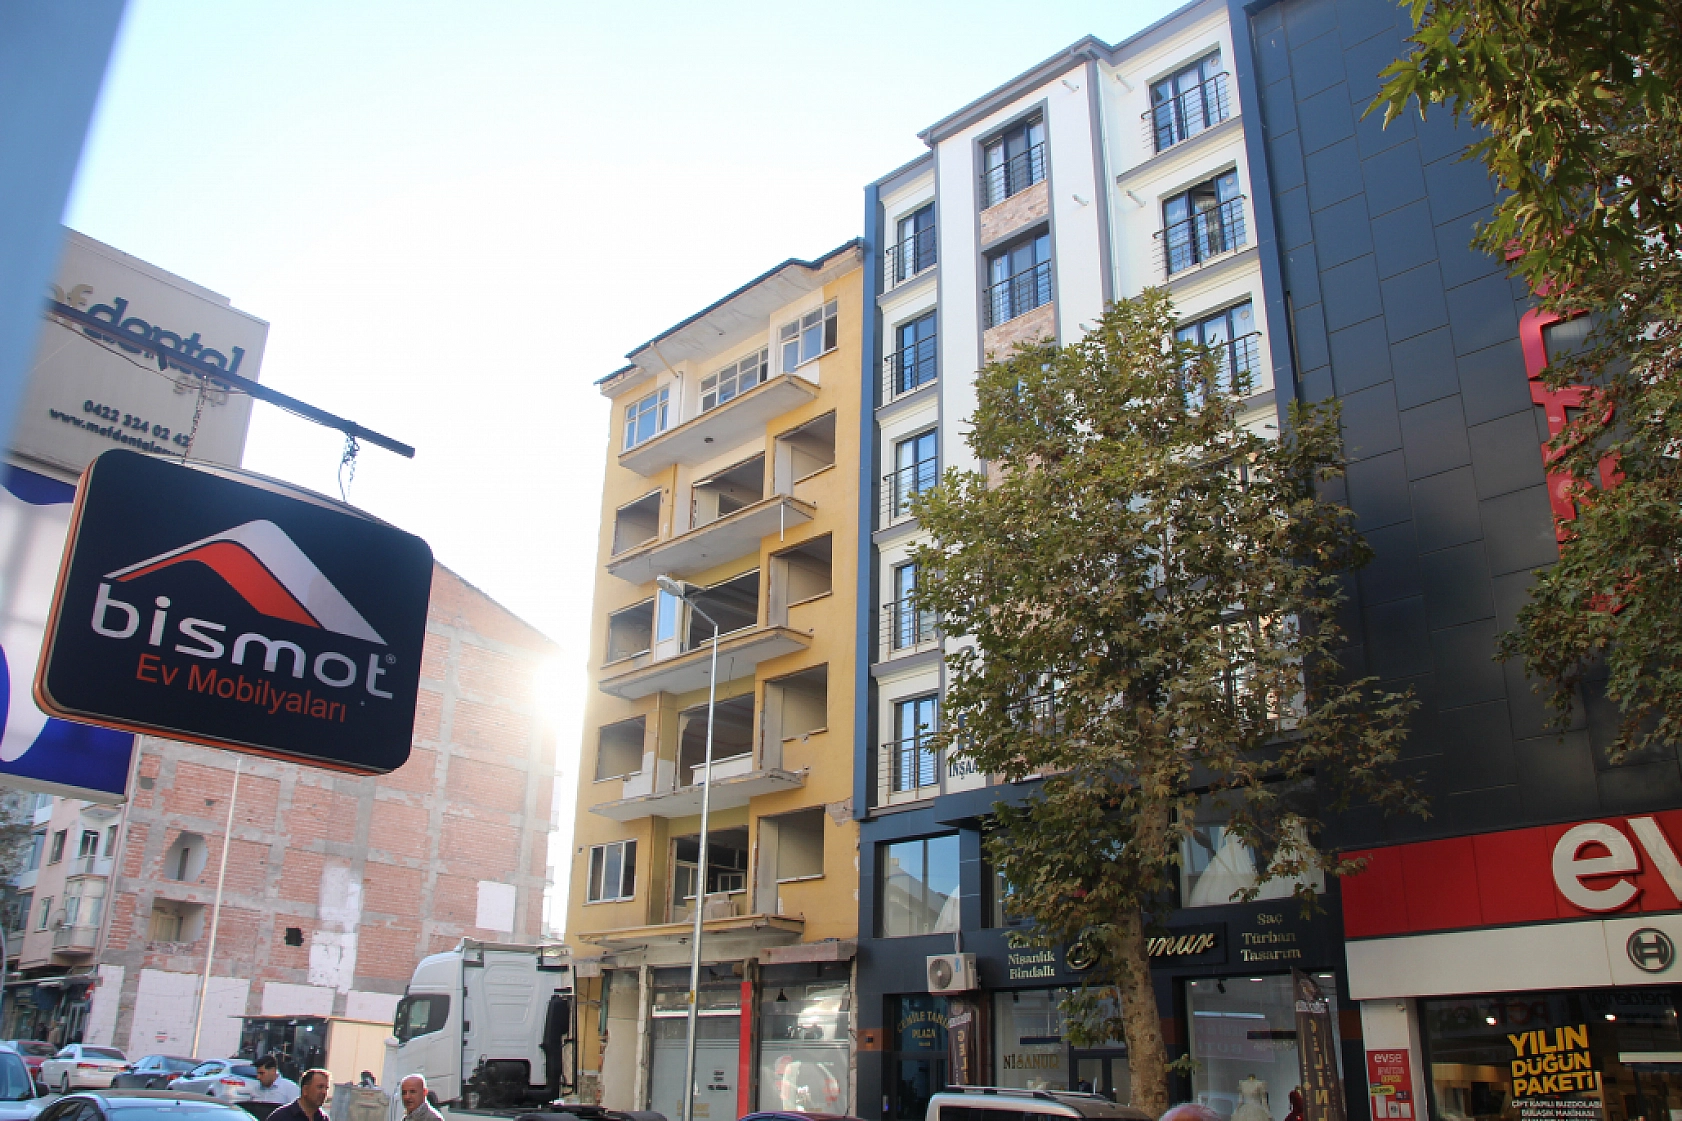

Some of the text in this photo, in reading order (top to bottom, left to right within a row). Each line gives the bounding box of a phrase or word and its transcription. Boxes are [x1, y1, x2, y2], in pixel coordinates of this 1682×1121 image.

[84, 399, 120, 423] 0422
[122, 413, 150, 434] 324
[152, 424, 170, 441] 02
[91, 583, 393, 700] bismot
[136, 654, 347, 723] Ev Mobilyaları
[1257, 913, 1283, 926] Saç
[1240, 948, 1302, 962] Tasarım
[912, 1029, 936, 1039] PLAZA
[1507, 1023, 1590, 1057] YILIN
[1374, 1053, 1402, 1064] evse
[1511, 1050, 1592, 1078] DÜĞÜN
[1513, 1070, 1595, 1098] PAKETİ
